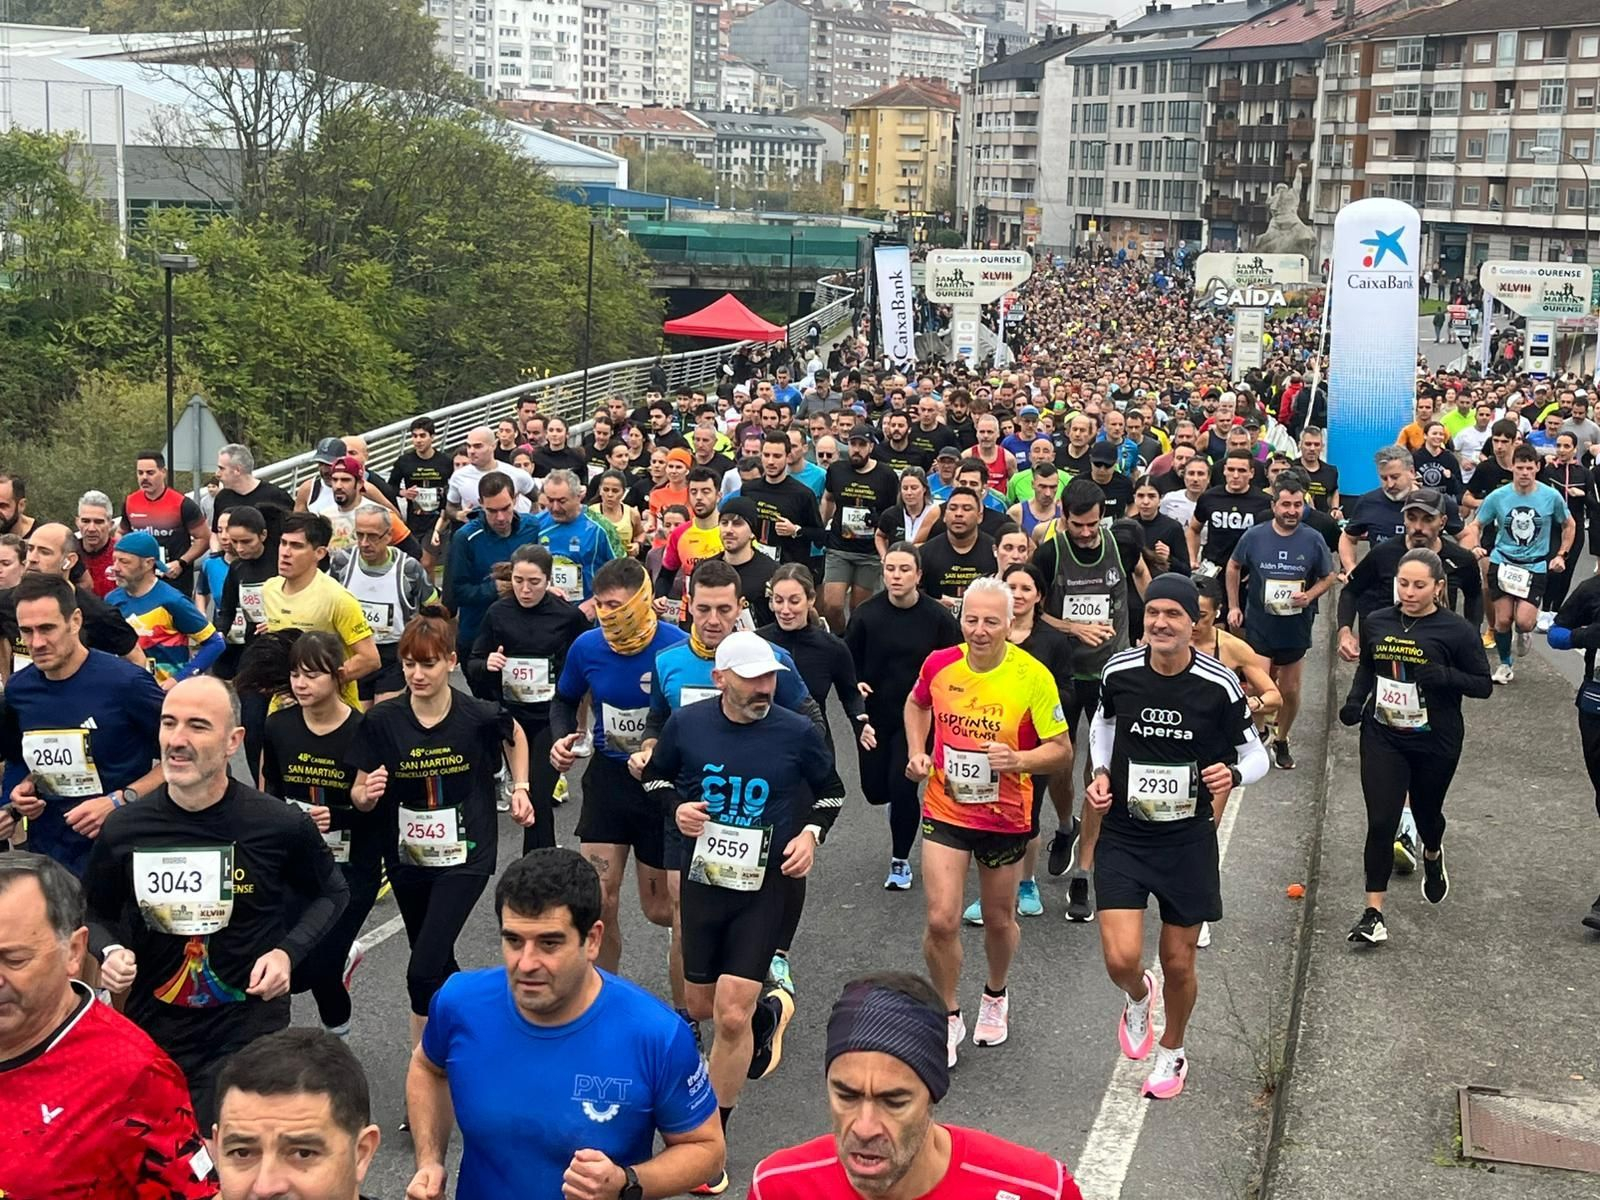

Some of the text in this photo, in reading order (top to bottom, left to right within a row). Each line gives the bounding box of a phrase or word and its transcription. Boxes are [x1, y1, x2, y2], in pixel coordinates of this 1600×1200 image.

[980, 256, 1021, 264] OURENSE
[982, 271, 1012, 281] XLVIII
[1347, 274, 1414, 289] CaixaBank
[1538, 268, 1582, 278] OURENSE
[1213, 284, 1287, 306] SAÍDA
[1499, 282, 1531, 293] XLVIII
[888, 269, 908, 360] CaixaBank
[1542, 305, 1583, 313] OURENSE
[1211, 511, 1255, 529] SIGA
[1071, 603, 1102, 616] 2006
[1389, 645, 1423, 657] MARTIÑO
[512, 668, 534, 681] 951
[1382, 688, 1408, 706] 2621
[611, 717, 645, 732] 1606
[1130, 722, 1194, 740] Apersa
[33, 748, 73, 766] 2840
[400, 754, 464, 771] SAN MARTIÑO
[288, 764, 345, 780] SAN MARTIÑO
[395, 768, 429, 778] CONCELLO
[948, 759, 980, 779] 3152
[1138, 777, 1178, 794] 2930
[406, 822, 445, 839] 2543
[707, 837, 749, 860] 9559
[147, 871, 202, 893] 3043
[573, 1074, 633, 1100] PYT
